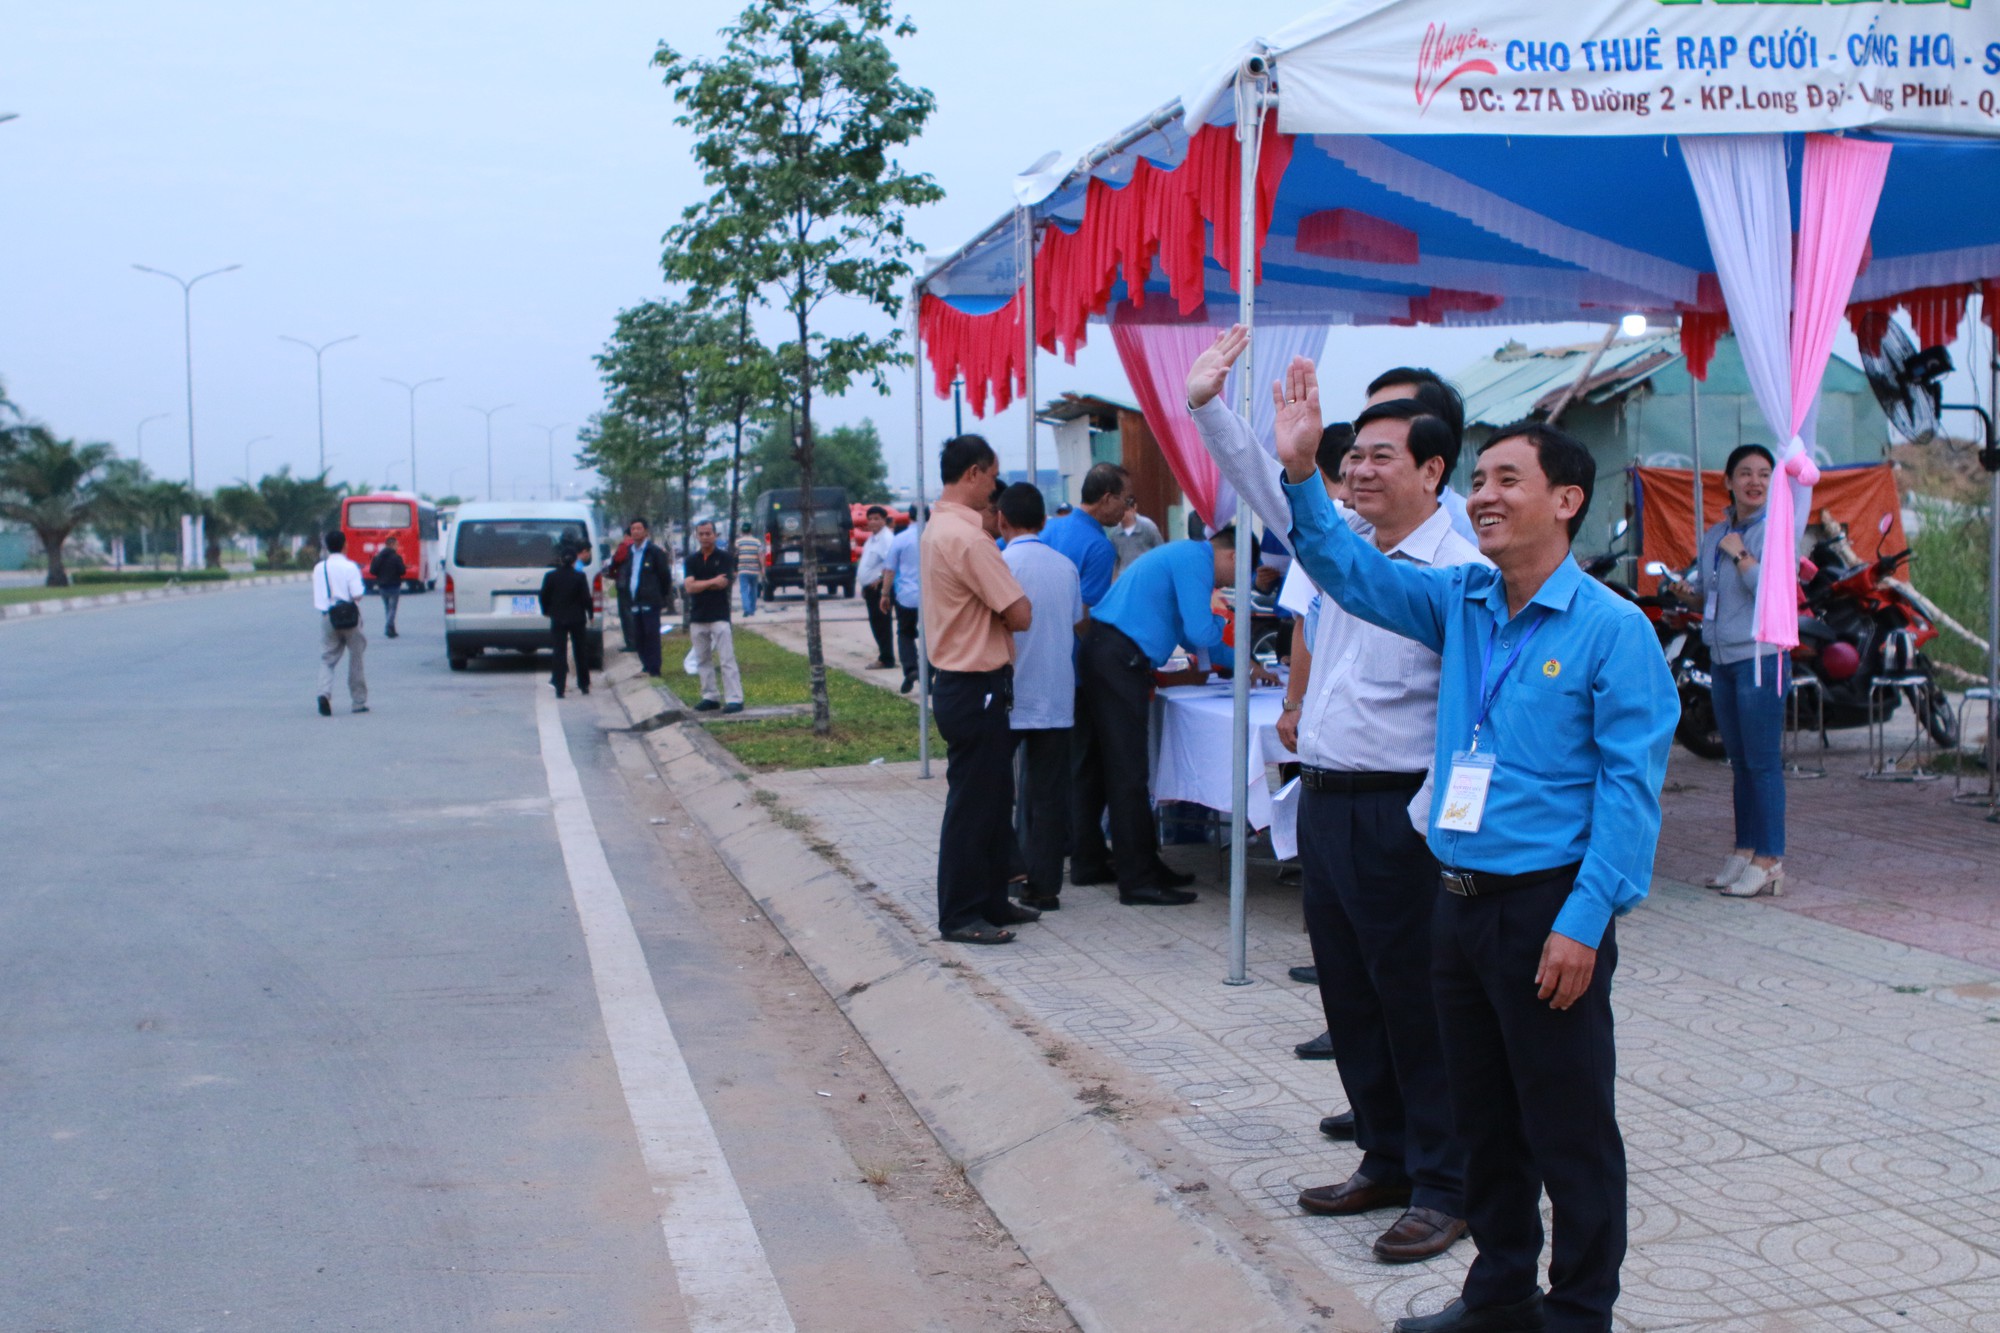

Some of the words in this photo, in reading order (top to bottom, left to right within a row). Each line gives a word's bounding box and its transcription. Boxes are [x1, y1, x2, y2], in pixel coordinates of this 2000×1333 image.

[1505, 39, 1571, 72] CHO
[1581, 27, 1663, 72] THUÊ
[1676, 35, 1738, 76] RẠP
[1748, 26, 1818, 68] CƯỚI
[1909, 33, 1955, 69] HO
[1460, 87, 1505, 112] ĐC:
[1513, 87, 1564, 111] 27A
[1572, 87, 1650, 116] Đường
[1660, 86, 1675, 110] 2
[1701, 86, 1797, 113] KP.Long
[1859, 82, 1894, 111] Lng
